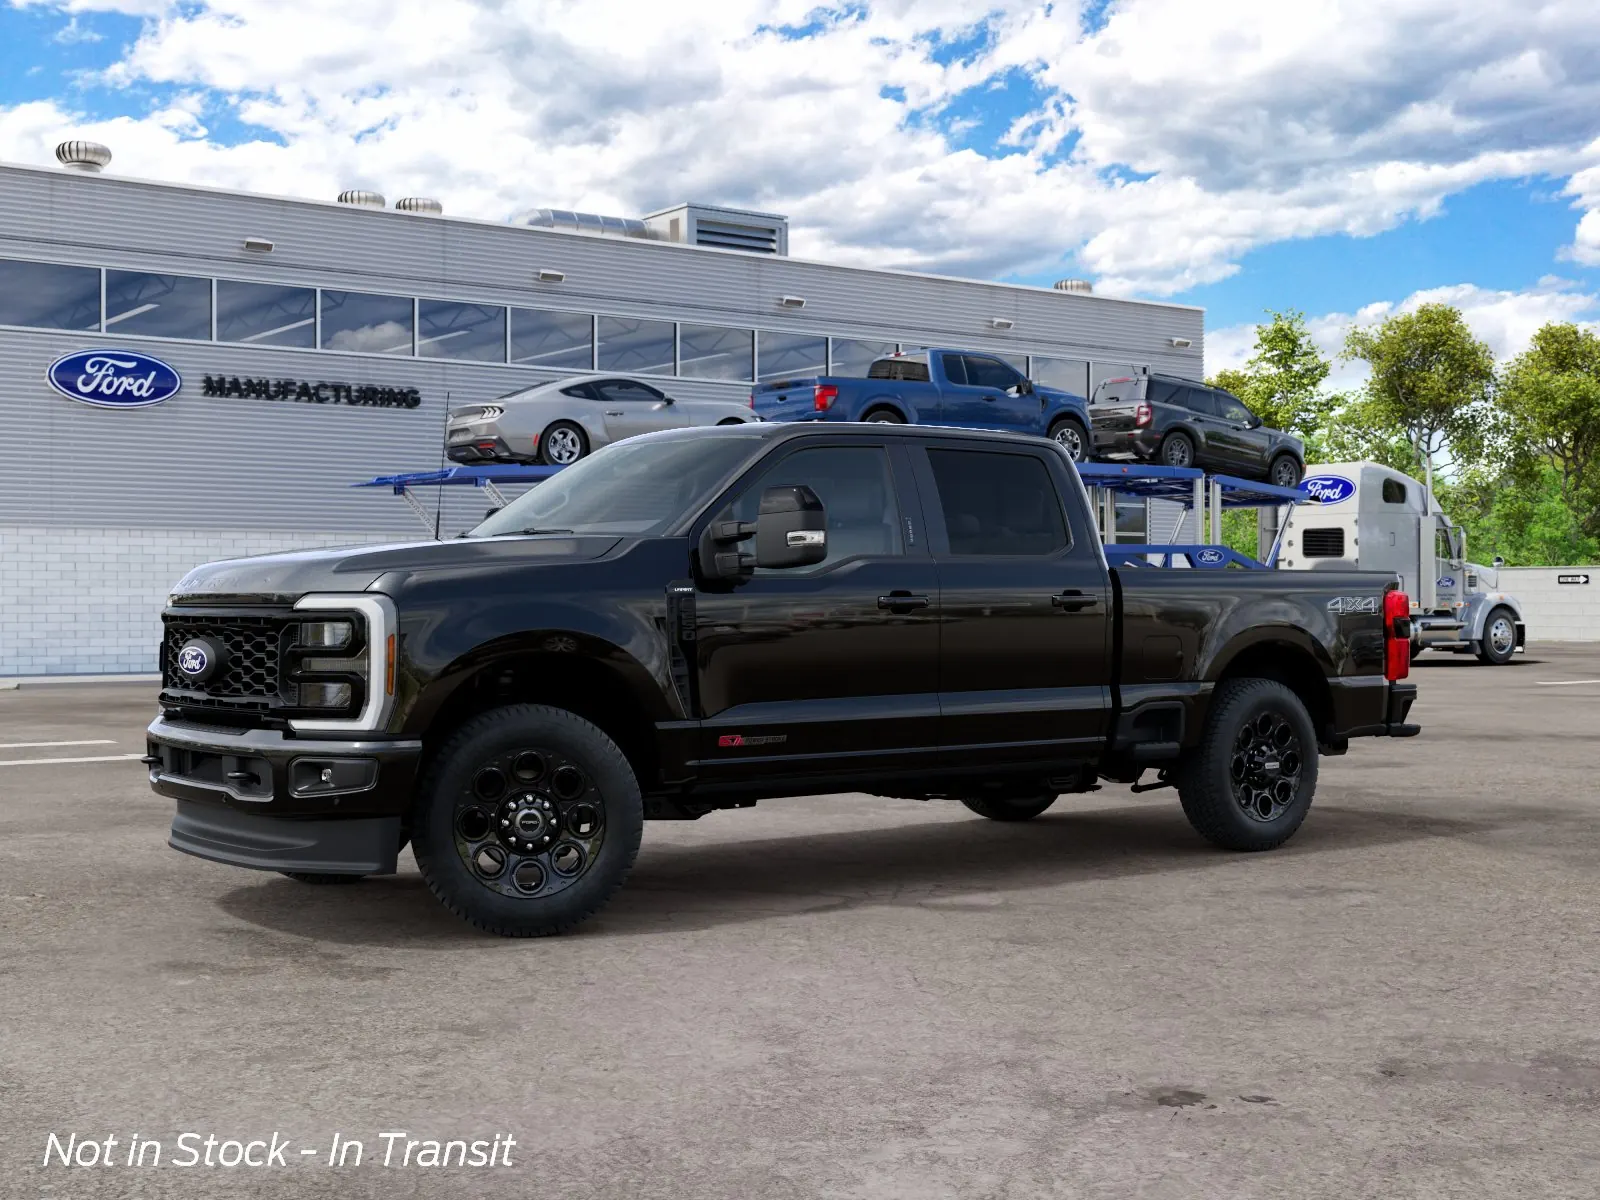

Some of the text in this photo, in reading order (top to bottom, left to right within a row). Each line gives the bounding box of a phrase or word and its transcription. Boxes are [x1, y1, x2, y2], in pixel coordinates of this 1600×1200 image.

[76, 356, 421, 408] Ford MANUFACTURING
[1305, 479, 1344, 500] Ford
[182, 650, 202, 670] Ford
